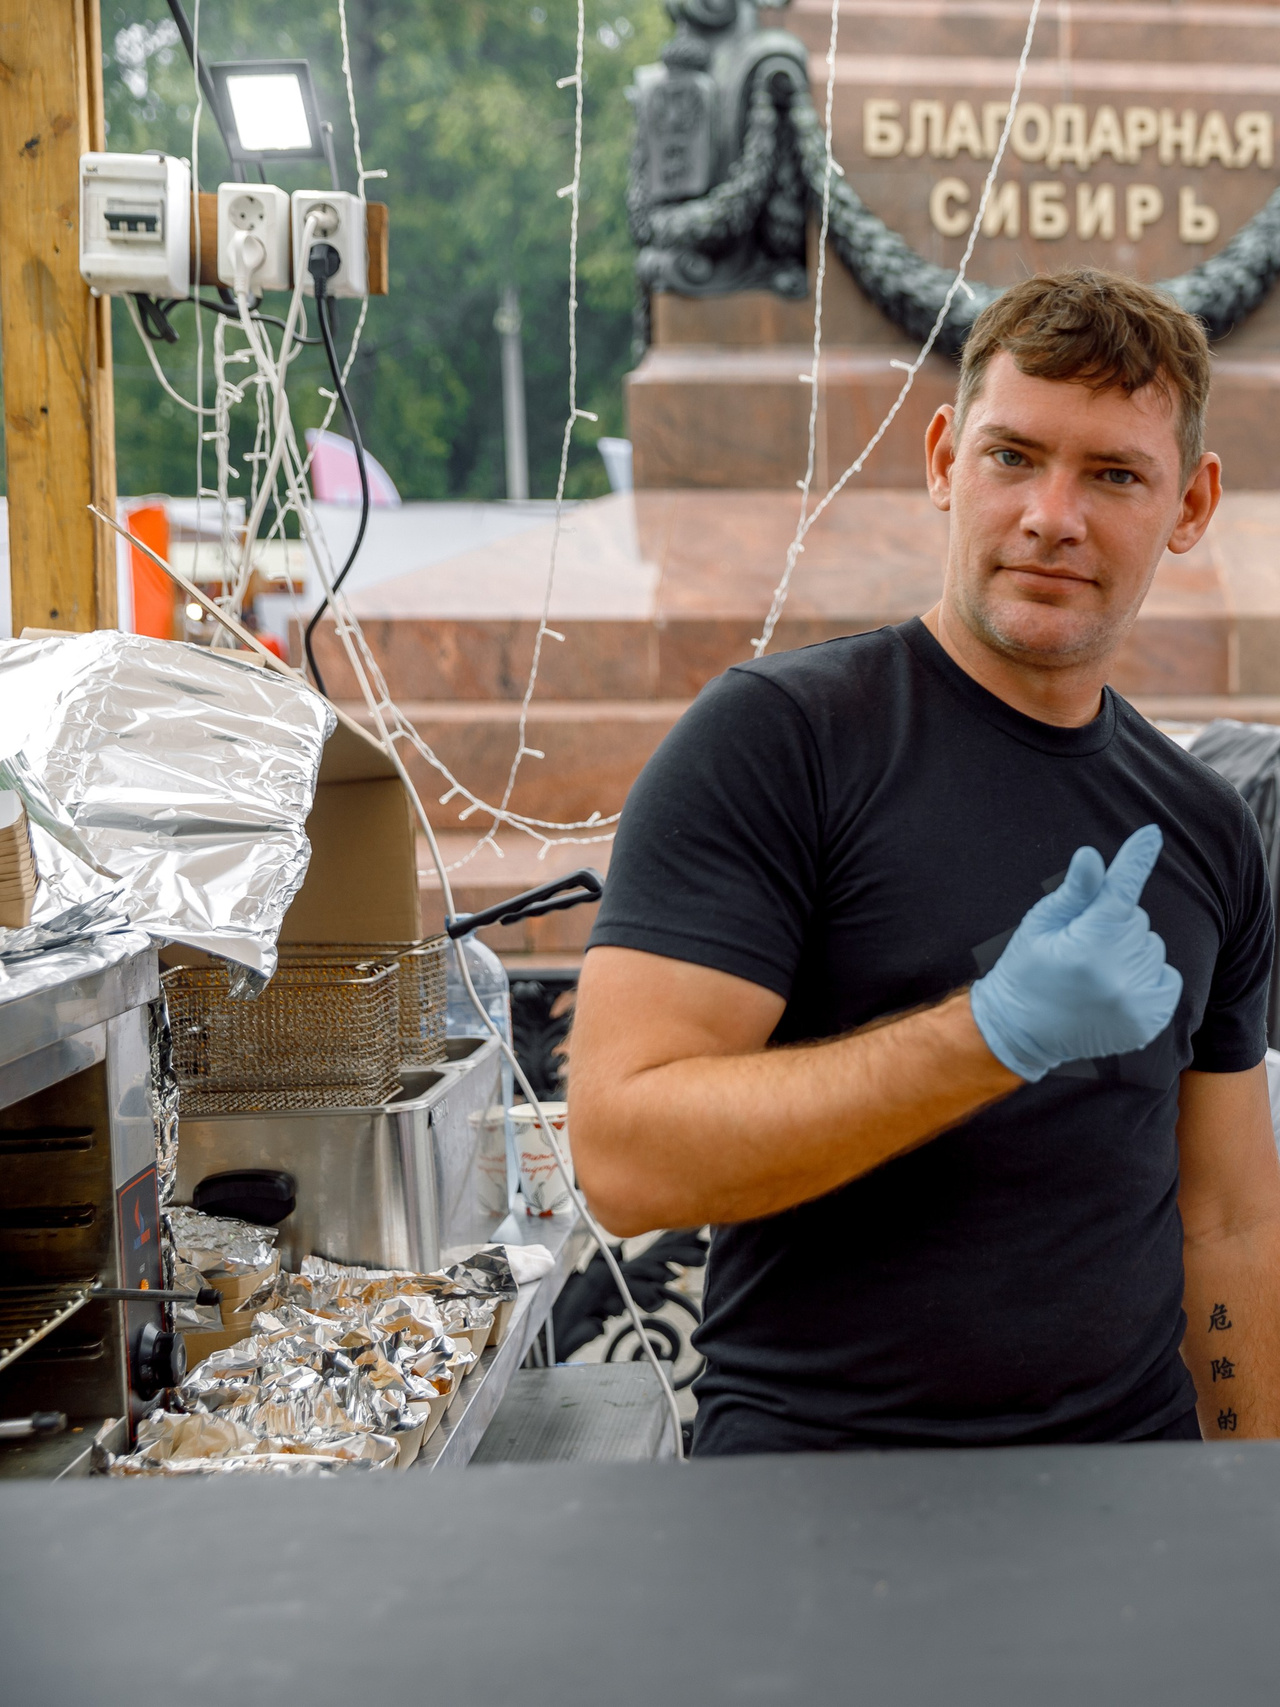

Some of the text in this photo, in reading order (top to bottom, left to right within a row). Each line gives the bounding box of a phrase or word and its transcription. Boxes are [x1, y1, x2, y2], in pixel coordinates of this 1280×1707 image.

[863, 99, 1275, 171] БЛАГОДАРНАЯ
[929, 177, 1220, 244] СИБИРЬ
[1207, 1303, 1238, 1432] 危险的
